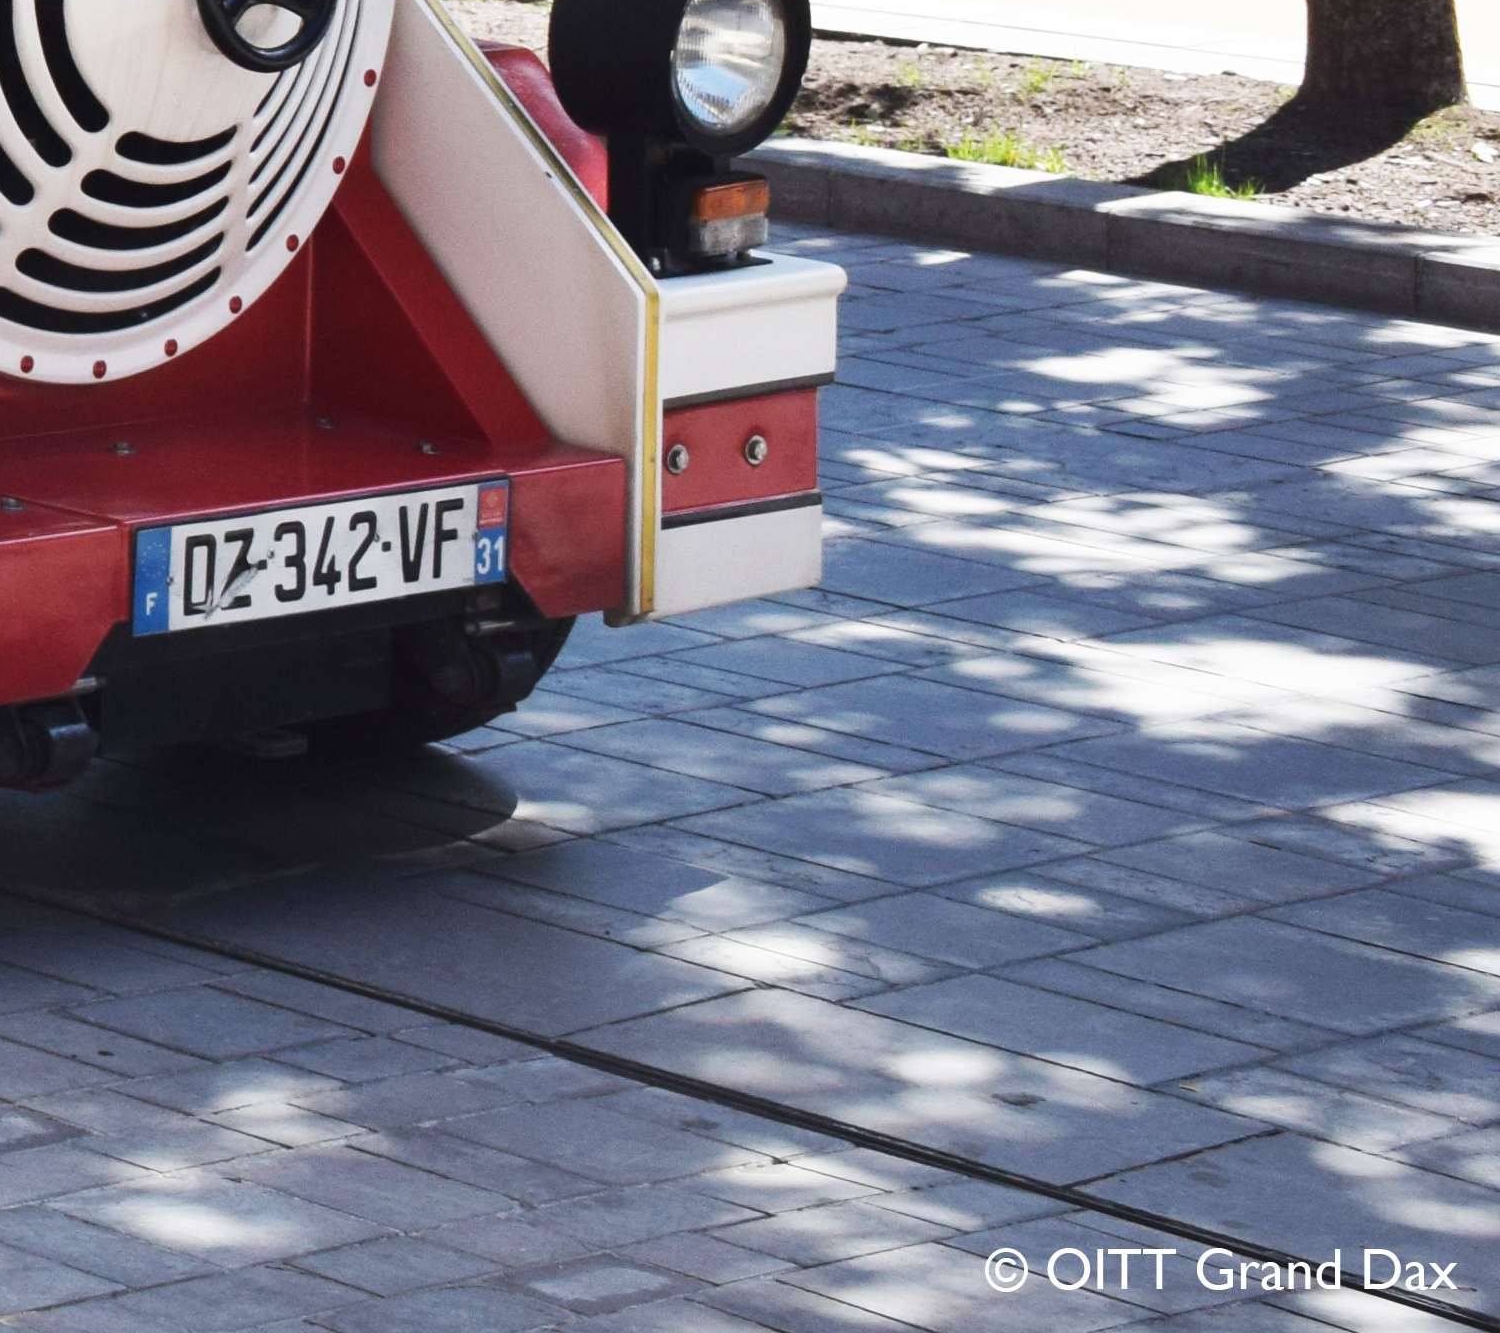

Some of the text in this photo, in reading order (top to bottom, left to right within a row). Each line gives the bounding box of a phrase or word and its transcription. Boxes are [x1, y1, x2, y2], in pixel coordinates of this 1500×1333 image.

[183, 498, 464, 616] DZ-342-VF
[477, 536, 504, 575] 31
[146, 593, 157, 616] F
